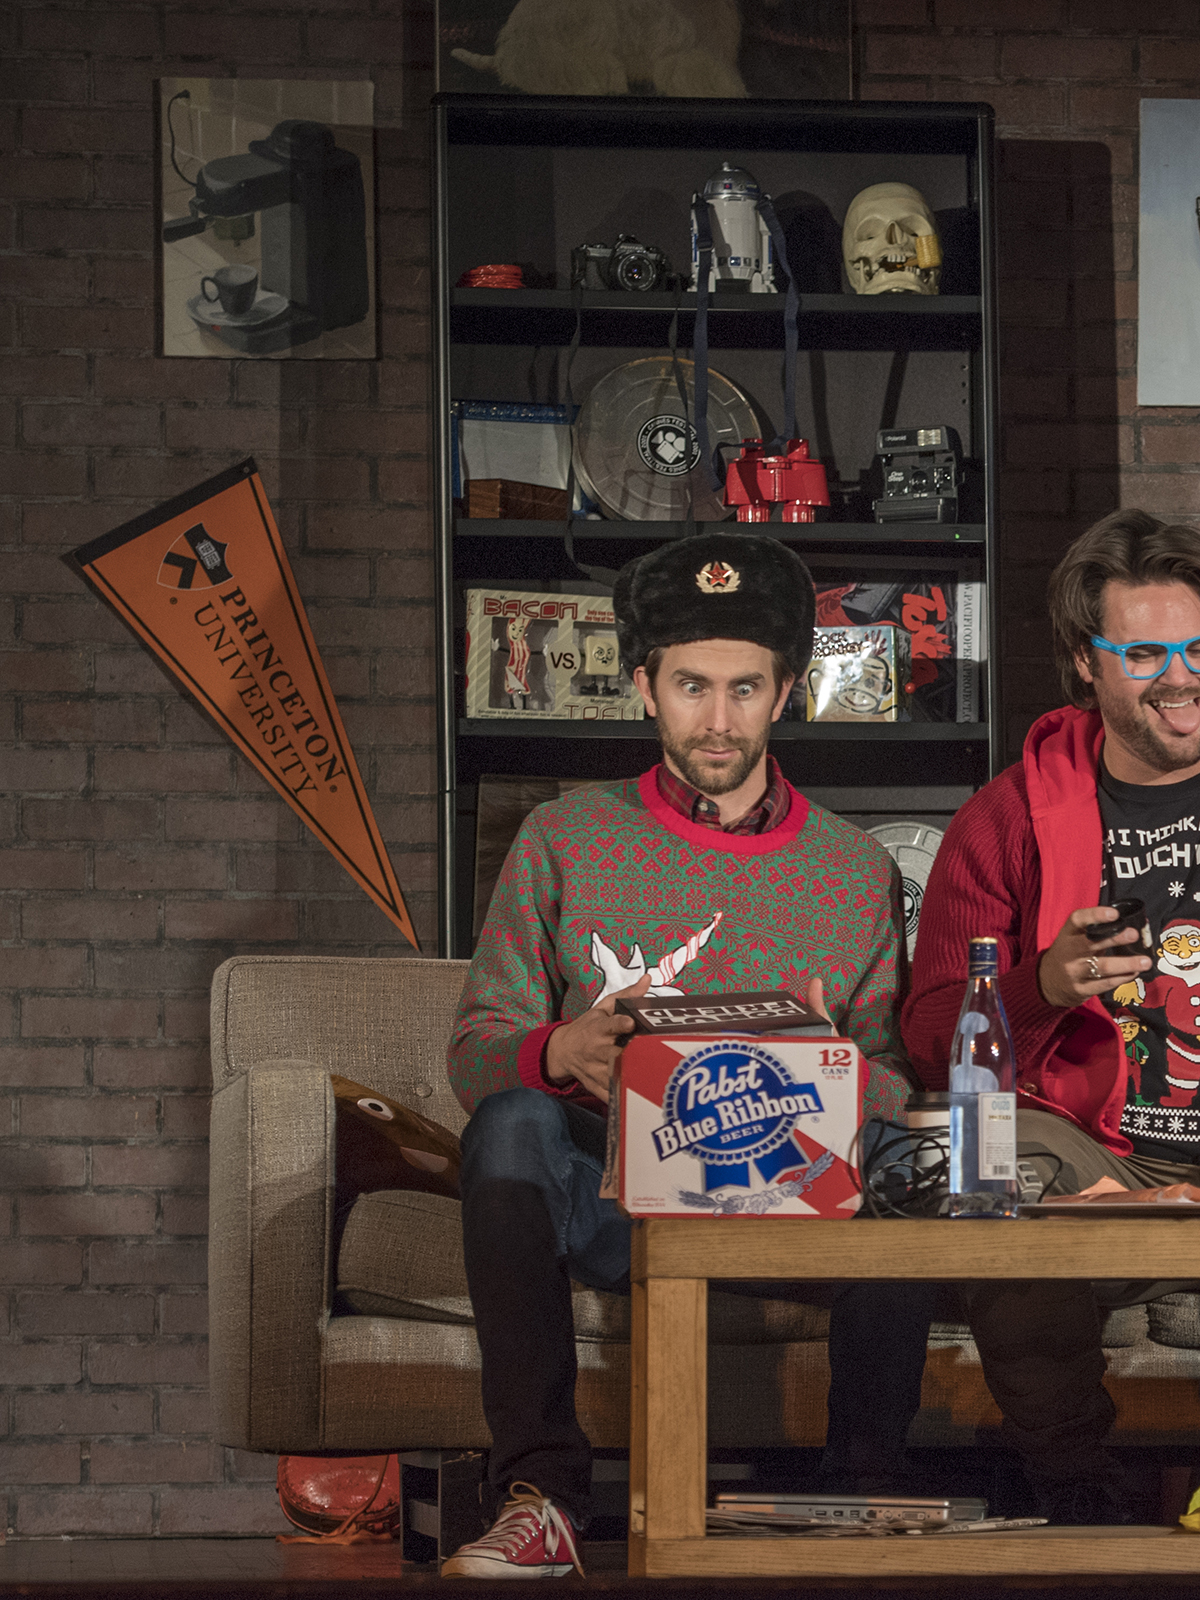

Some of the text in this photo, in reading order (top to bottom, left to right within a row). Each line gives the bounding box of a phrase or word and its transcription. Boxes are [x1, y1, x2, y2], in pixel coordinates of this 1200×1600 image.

[550, 652, 577, 670] VS.
[218, 586, 346, 783] PRINCETON
[193, 600, 319, 797] UNIVERSITY
[564, 704, 637, 720] TOFU
[1118, 828, 1131, 846] I
[1136, 815, 1198, 847] THINK
[1113, 842, 1191, 879] OUCH
[645, 1000, 795, 1018] FRIEND
[655, 1007, 799, 1026] DONUT
[818, 1048, 852, 1067] 12
[821, 1067, 849, 1075] CANS
[678, 1060, 764, 1110] Pabst
[655, 1091, 820, 1158] Blue Ribbon
[720, 1124, 765, 1144] BEER
